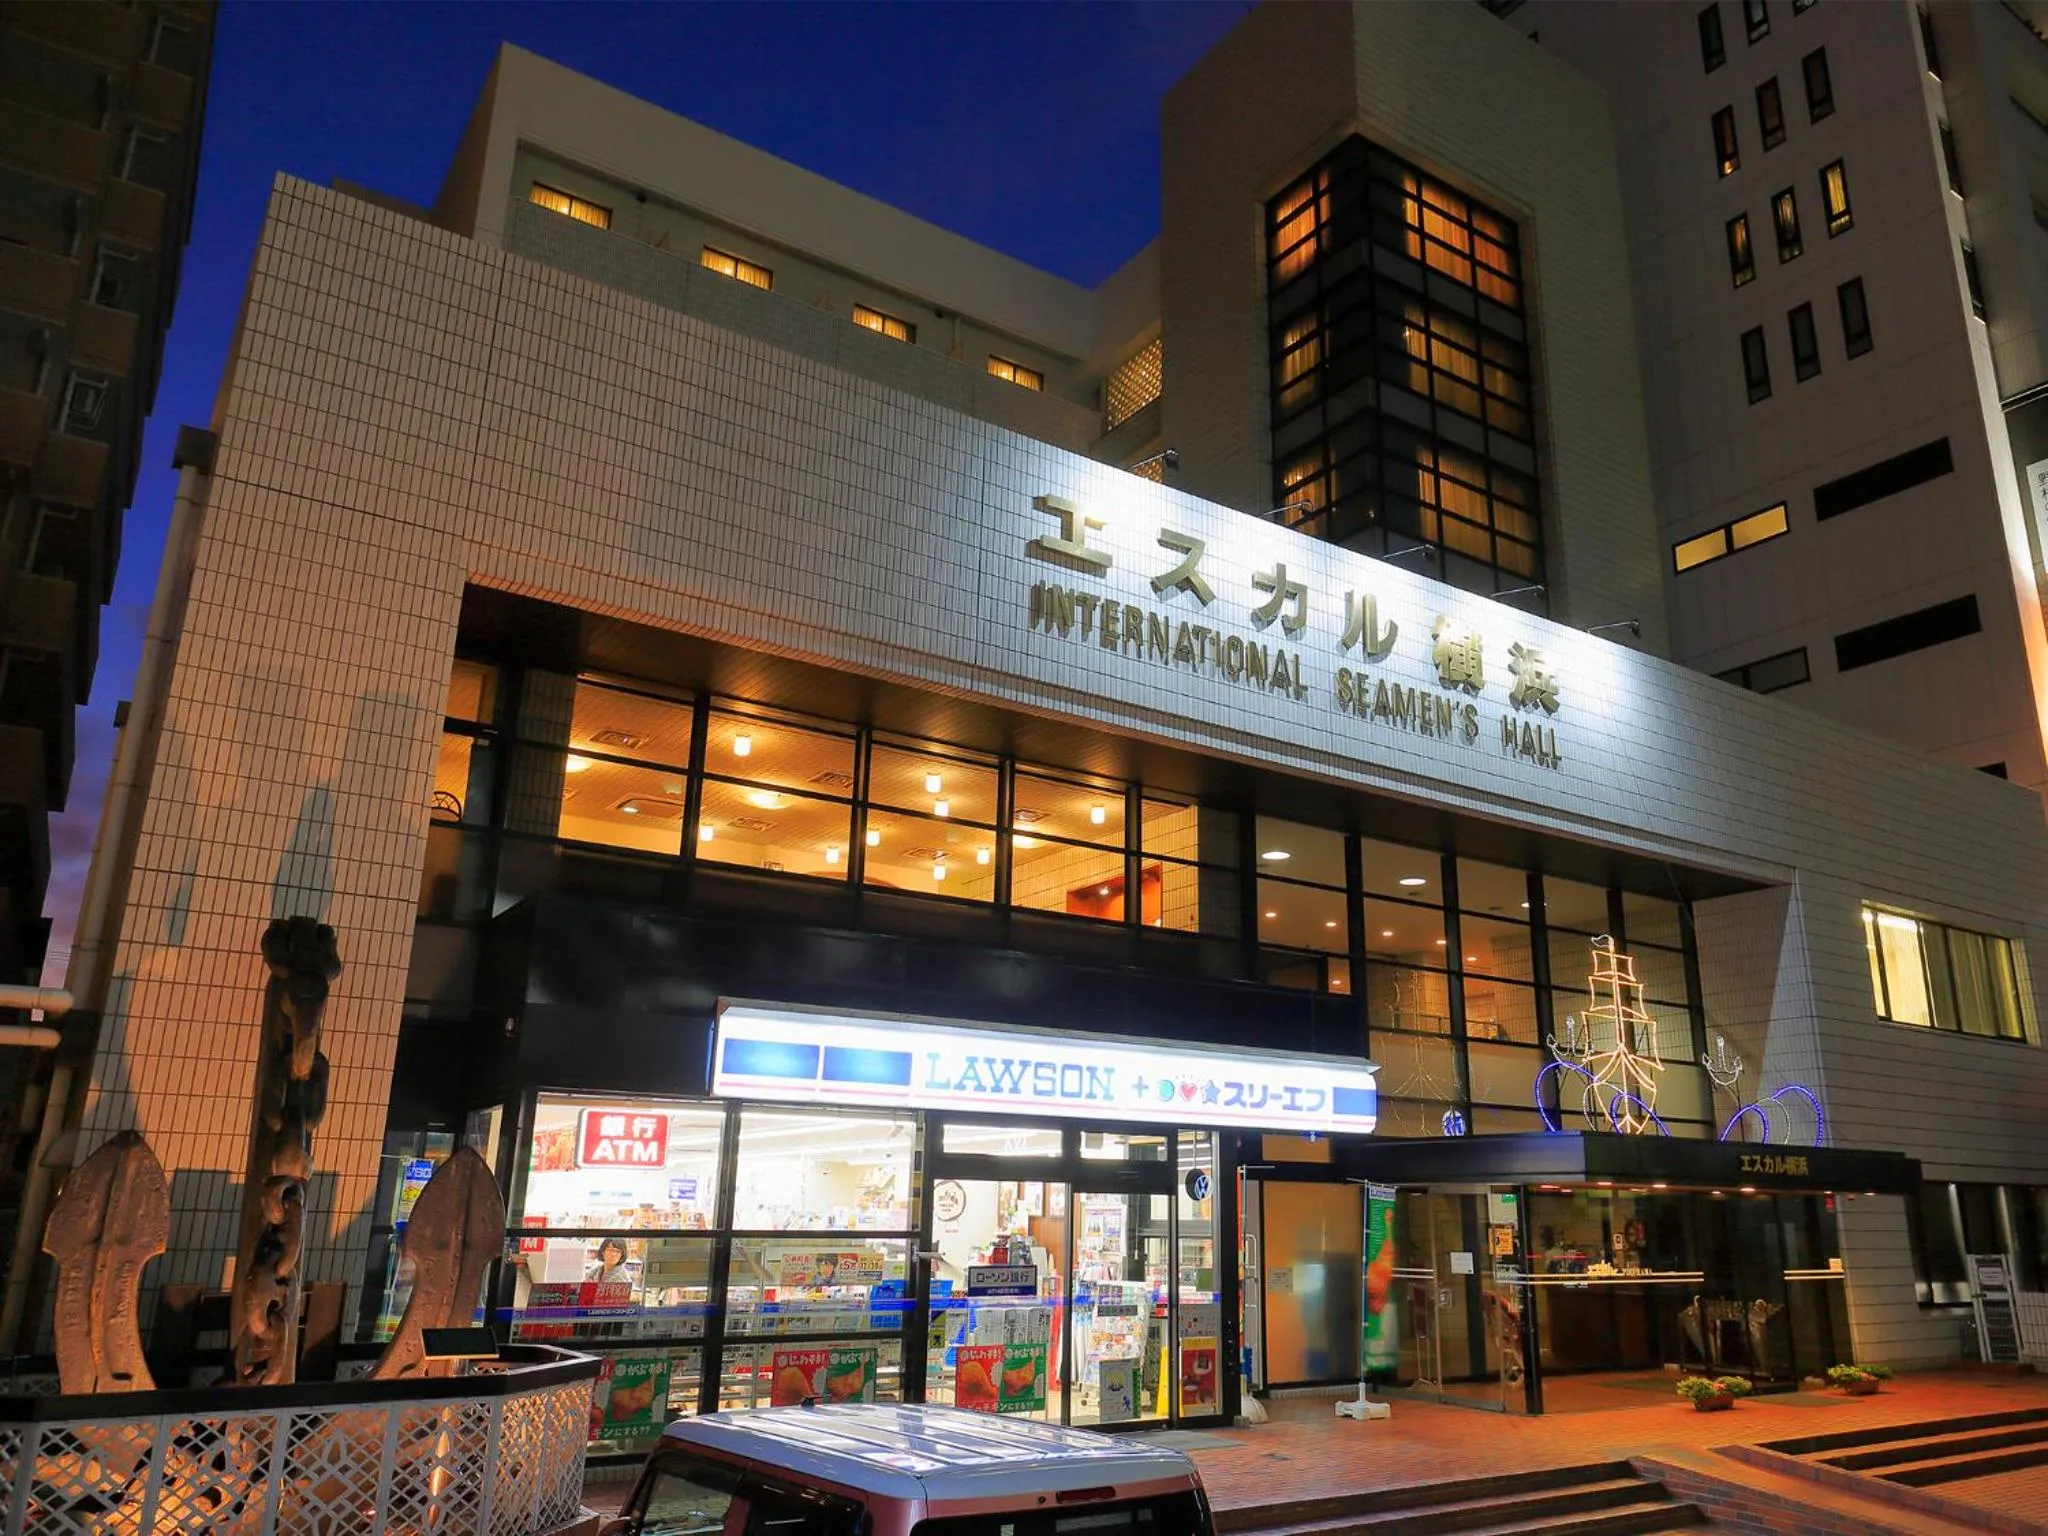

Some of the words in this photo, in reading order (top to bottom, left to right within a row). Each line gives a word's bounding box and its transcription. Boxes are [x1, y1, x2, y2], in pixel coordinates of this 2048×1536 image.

[1026, 494, 1560, 714] エスカル横浜
[1032, 580, 1308, 700] INTERNATIONAL
[1335, 667, 1479, 745] SEAMEN'S
[1501, 714, 1562, 769] HALL
[925, 1053, 1116, 1101] LAWSON
[1223, 1081, 1327, 1113] スリーエフ
[599, 1114, 658, 1138] 銀行
[591, 1139, 658, 1162] ATM
[1740, 1154, 1809, 1177] エスカル横浜
